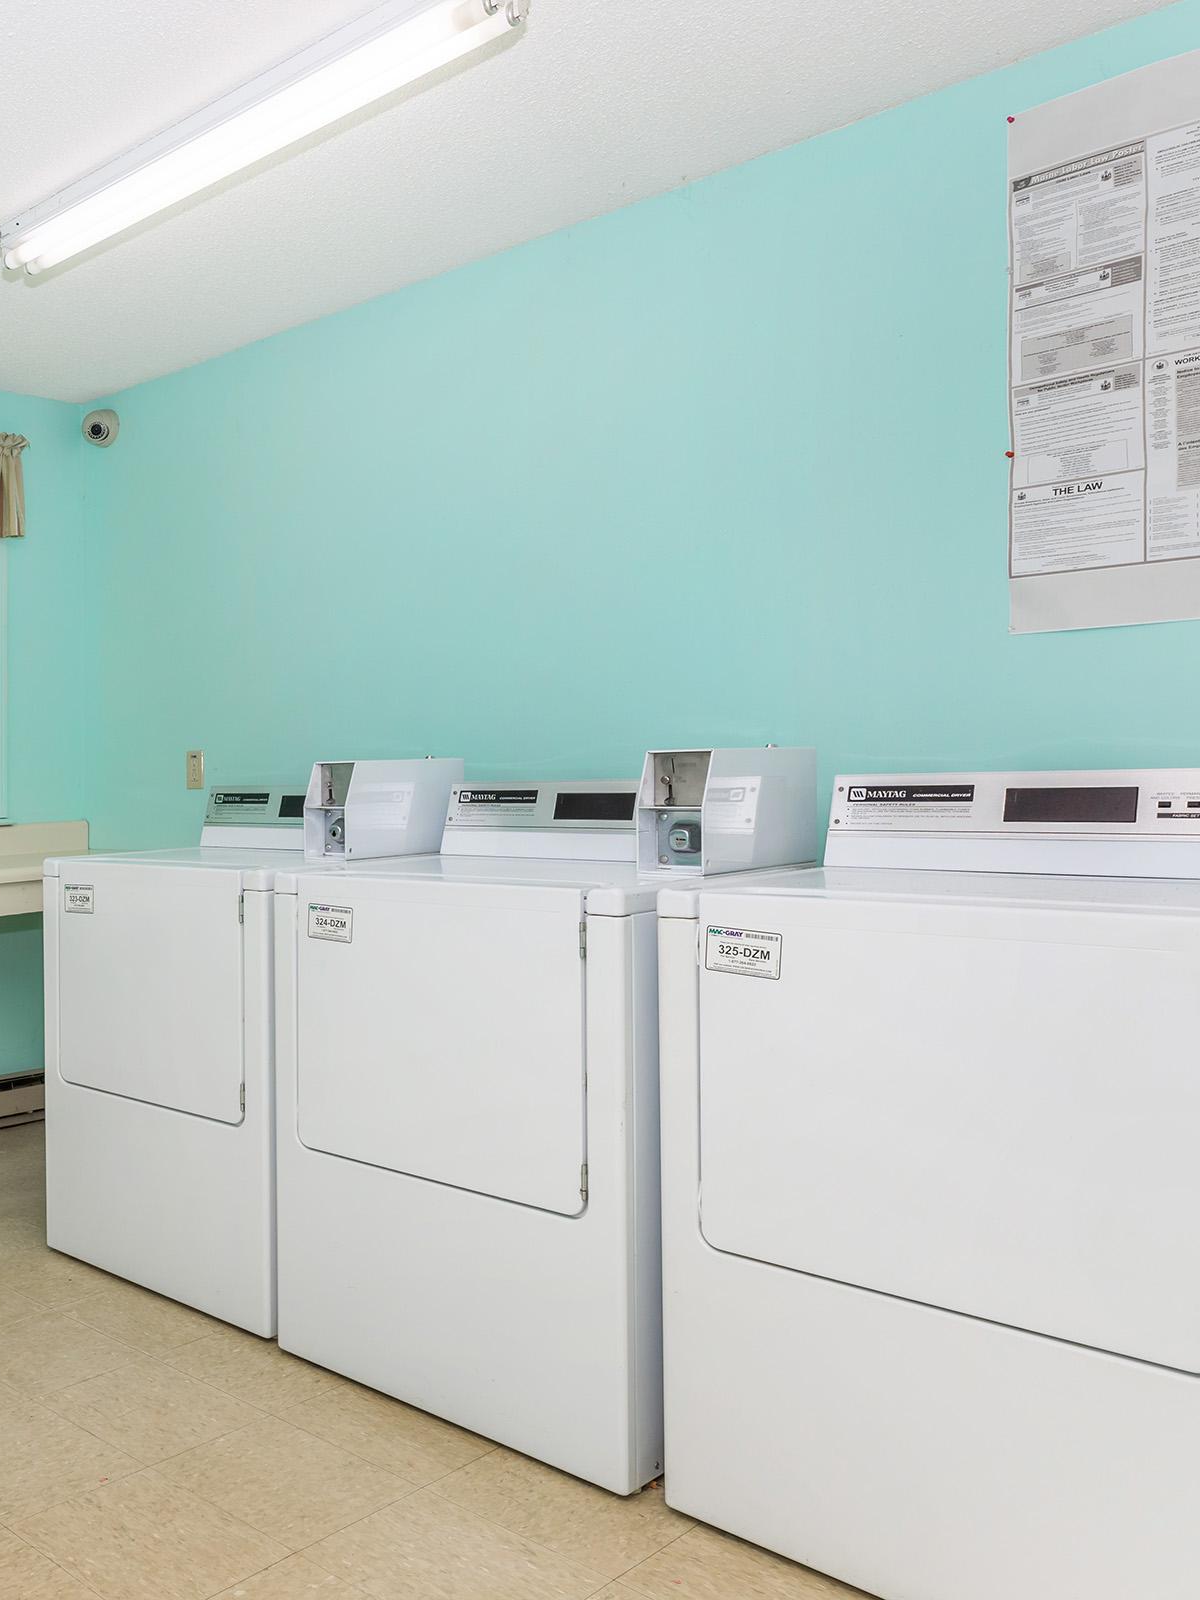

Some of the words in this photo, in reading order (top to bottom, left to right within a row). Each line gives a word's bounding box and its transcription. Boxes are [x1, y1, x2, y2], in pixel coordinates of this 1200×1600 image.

[1030, 171, 1059, 185] Maine
[1061, 161, 1088, 176] Labor
[1089, 155, 1109, 166] Law
[1111, 143, 1144, 158] Poster
[1052, 486, 1074, 496] THE
[1077, 481, 1103, 493] LAW
[867, 790, 906, 799] MAYTAG
[315, 917, 347, 928] 324-DZM
[708, 928, 744, 938] MAC-GRAY
[718, 944, 771, 961] 325-DZM
